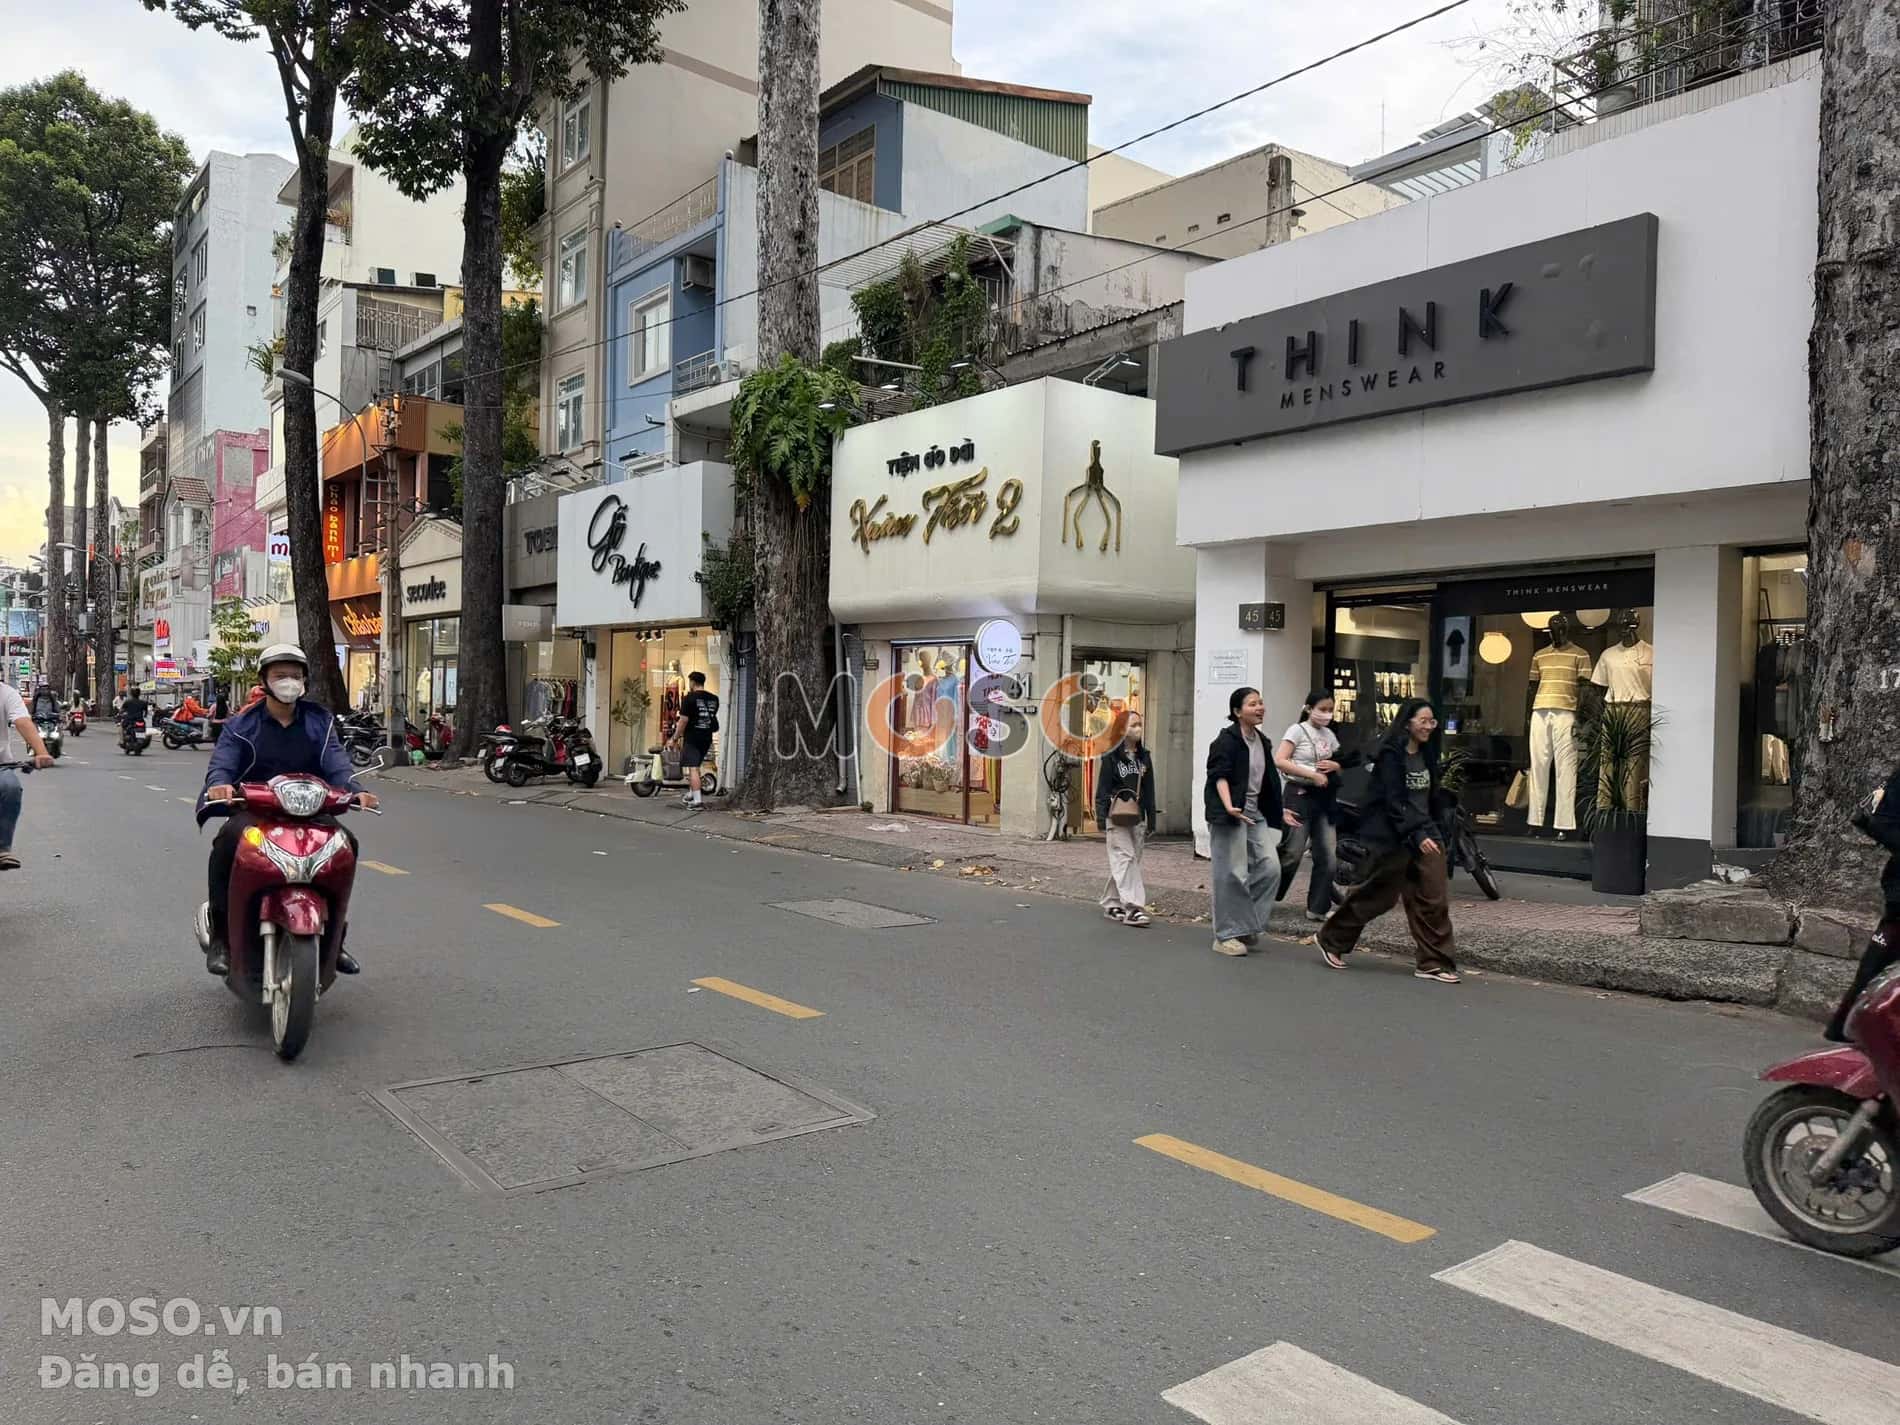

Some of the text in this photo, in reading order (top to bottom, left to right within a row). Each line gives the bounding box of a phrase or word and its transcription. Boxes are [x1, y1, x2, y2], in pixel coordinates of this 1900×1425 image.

[1231, 281, 1516, 393] THINK
[1280, 361, 1448, 410] MENSWEAR
[988, 478, 1024, 540] 2
[1505, 583, 1609, 597] THINK MENSWEAR
[1245, 609, 1260, 623] 45
[1268, 610, 1281, 623] 45
